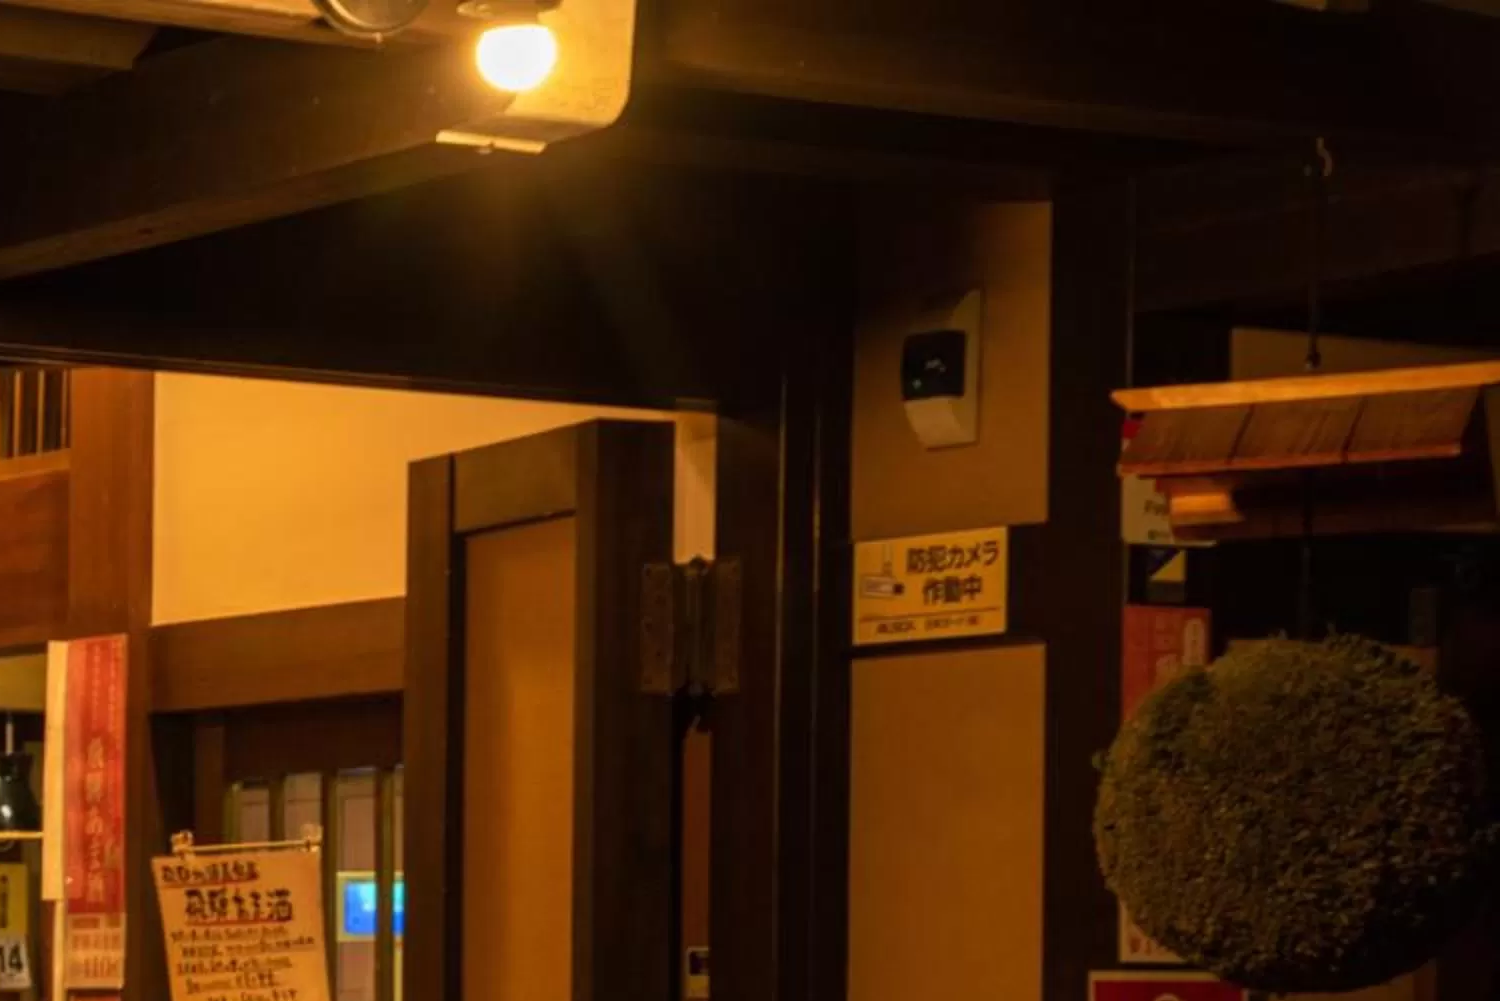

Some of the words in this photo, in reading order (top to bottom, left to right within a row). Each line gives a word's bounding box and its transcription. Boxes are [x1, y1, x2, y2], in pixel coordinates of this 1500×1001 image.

[907, 540, 999, 573] 防犯カメラ
